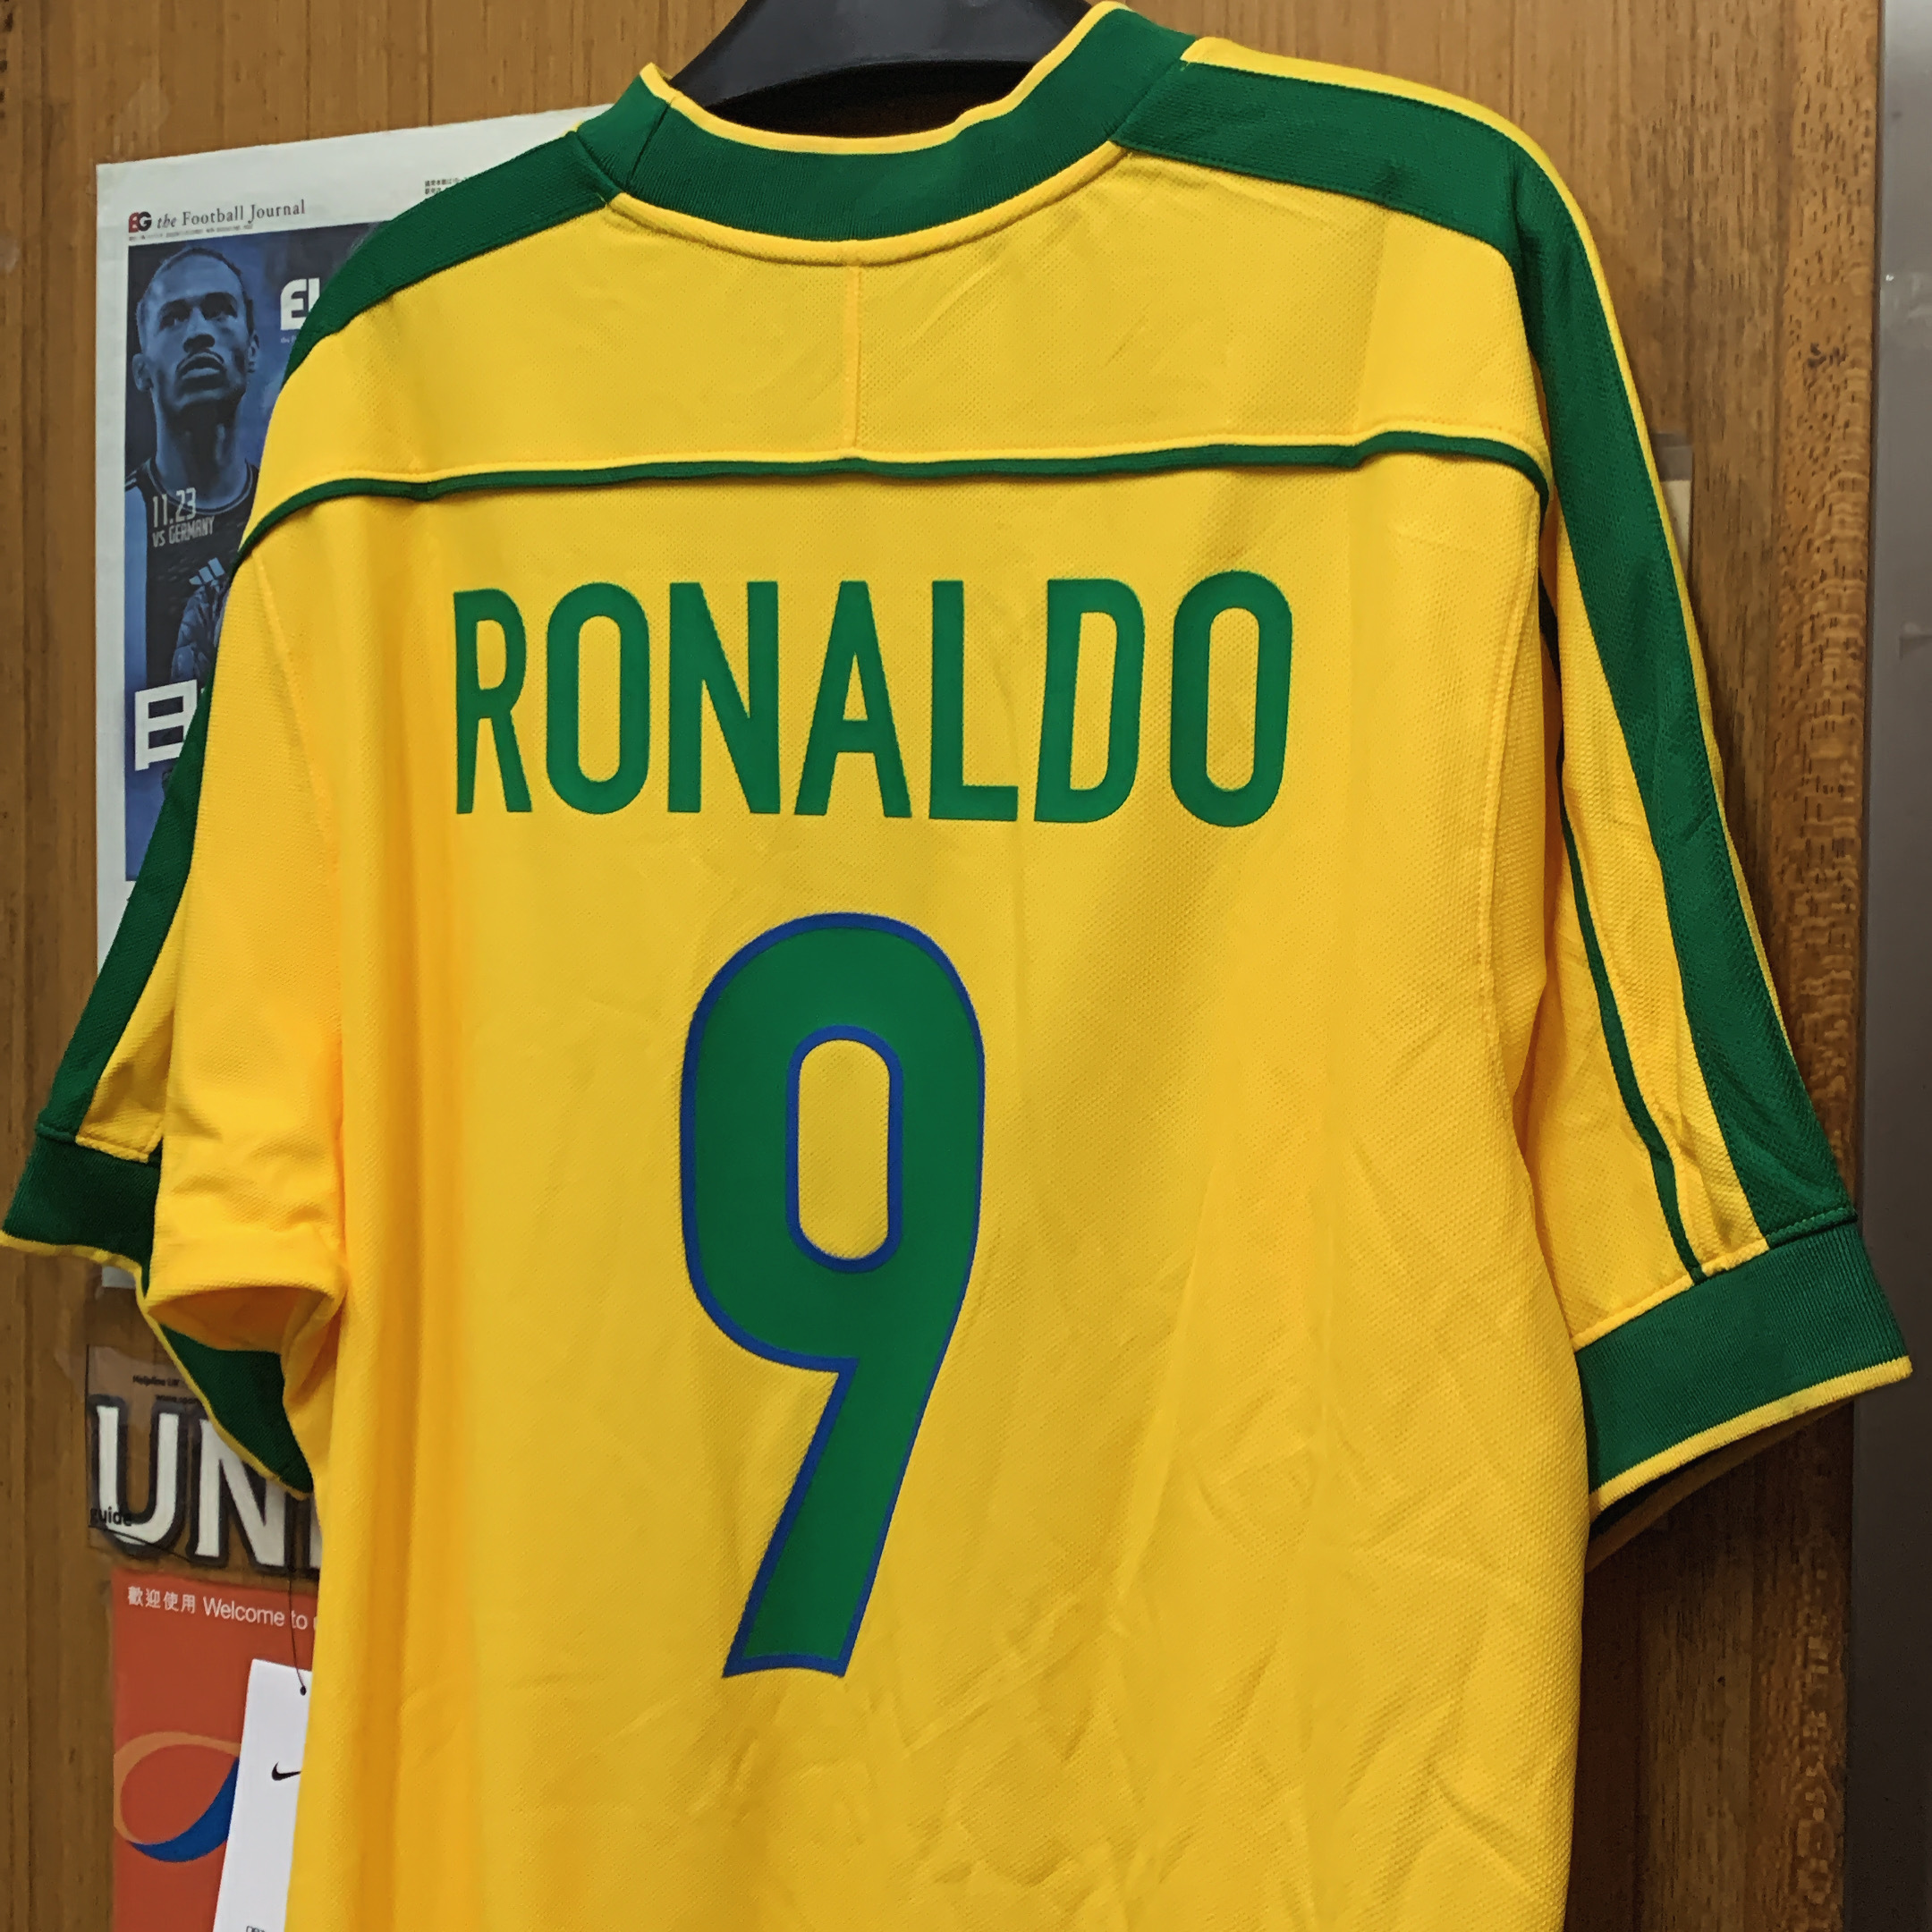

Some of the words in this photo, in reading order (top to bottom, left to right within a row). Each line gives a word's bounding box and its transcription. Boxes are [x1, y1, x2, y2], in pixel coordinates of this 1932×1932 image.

[157, 213, 177, 229] the
[182, 205, 244, 225] Football
[248, 199, 306, 224] Journal
[152, 487, 197, 528] 11.23
[152, 530, 166, 547] VS
[168, 515, 216, 545] GERMANY
[453, 570, 1292, 827] RONALDO
[680, 911, 986, 1678] 9
[127, 1586, 196, 1614] 歡迎使用
[202, 1596, 284, 1627] Welcome
[291, 1610, 308, 1631] to
